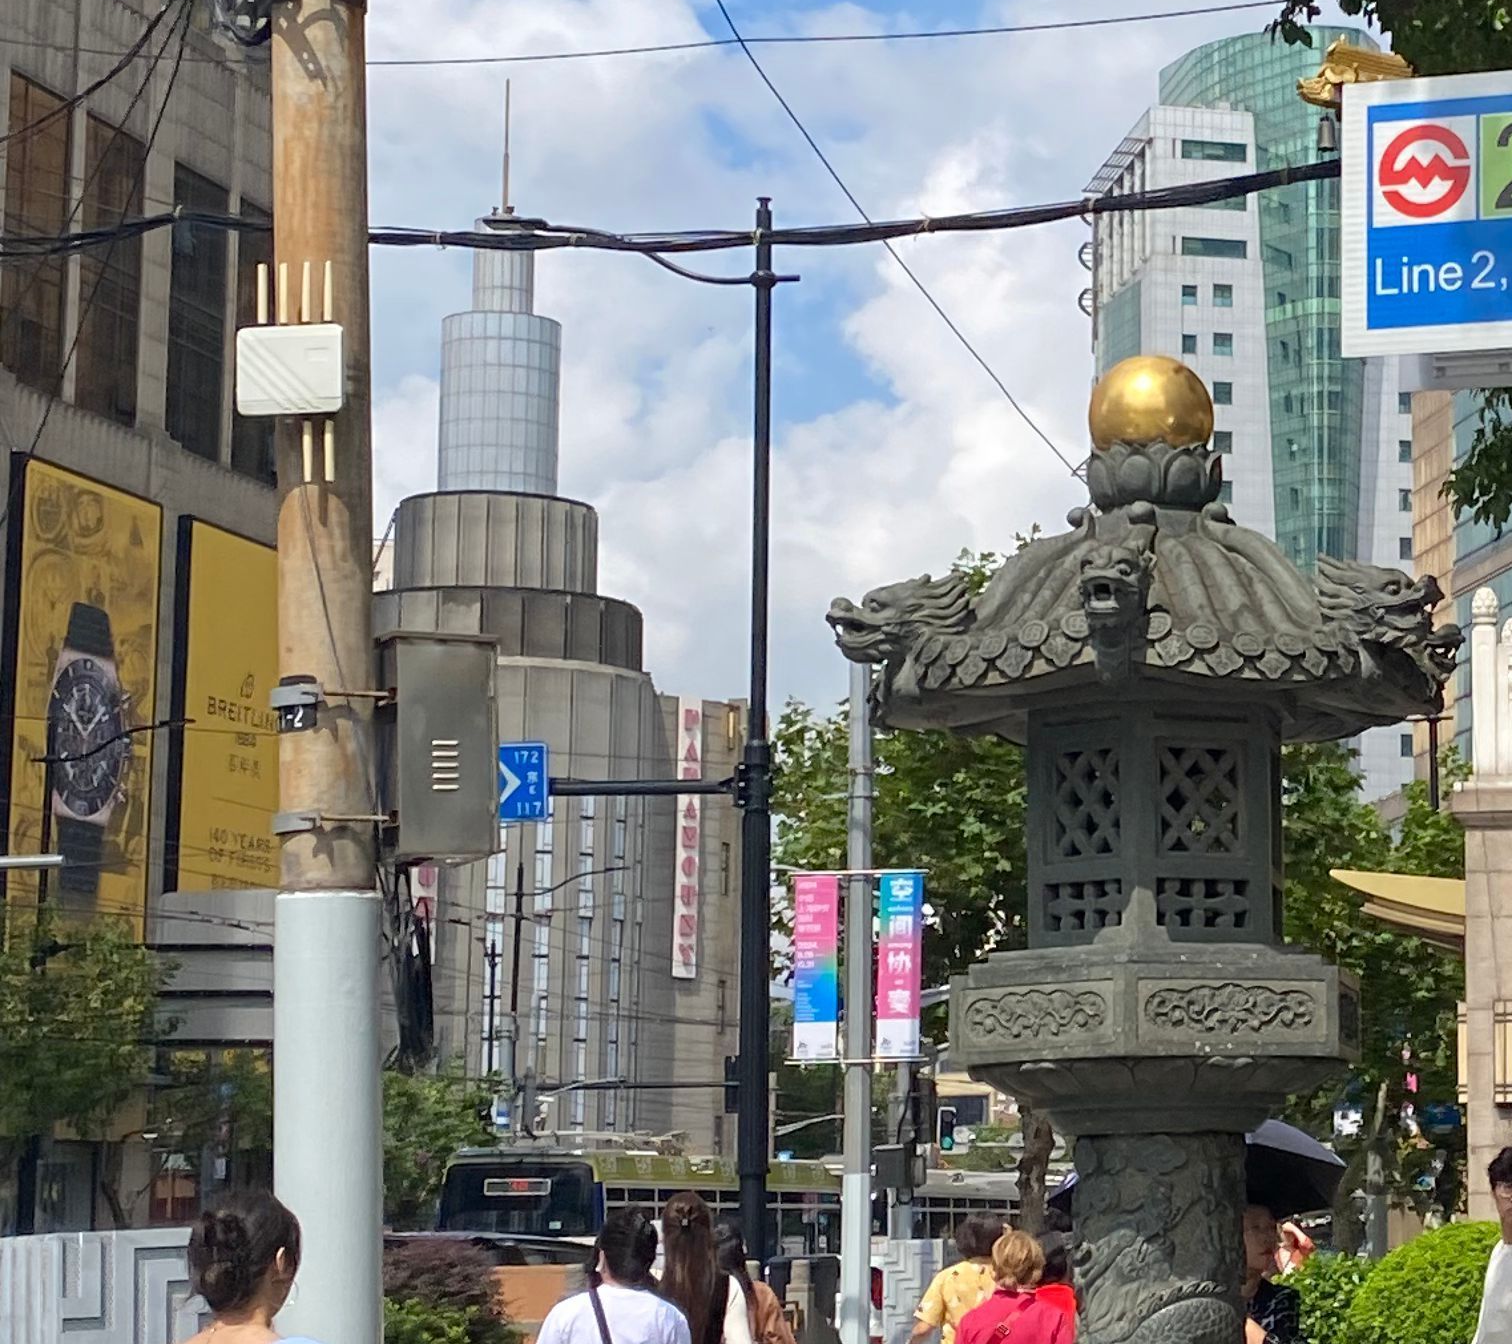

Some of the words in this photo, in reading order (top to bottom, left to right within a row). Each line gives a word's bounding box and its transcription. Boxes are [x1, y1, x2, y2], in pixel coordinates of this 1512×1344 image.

[1374, 255, 1464, 297] Line
[206, 695, 280, 734] BREITLIN
[513, 750, 540, 765] 172
[516, 800, 542, 817] 117
